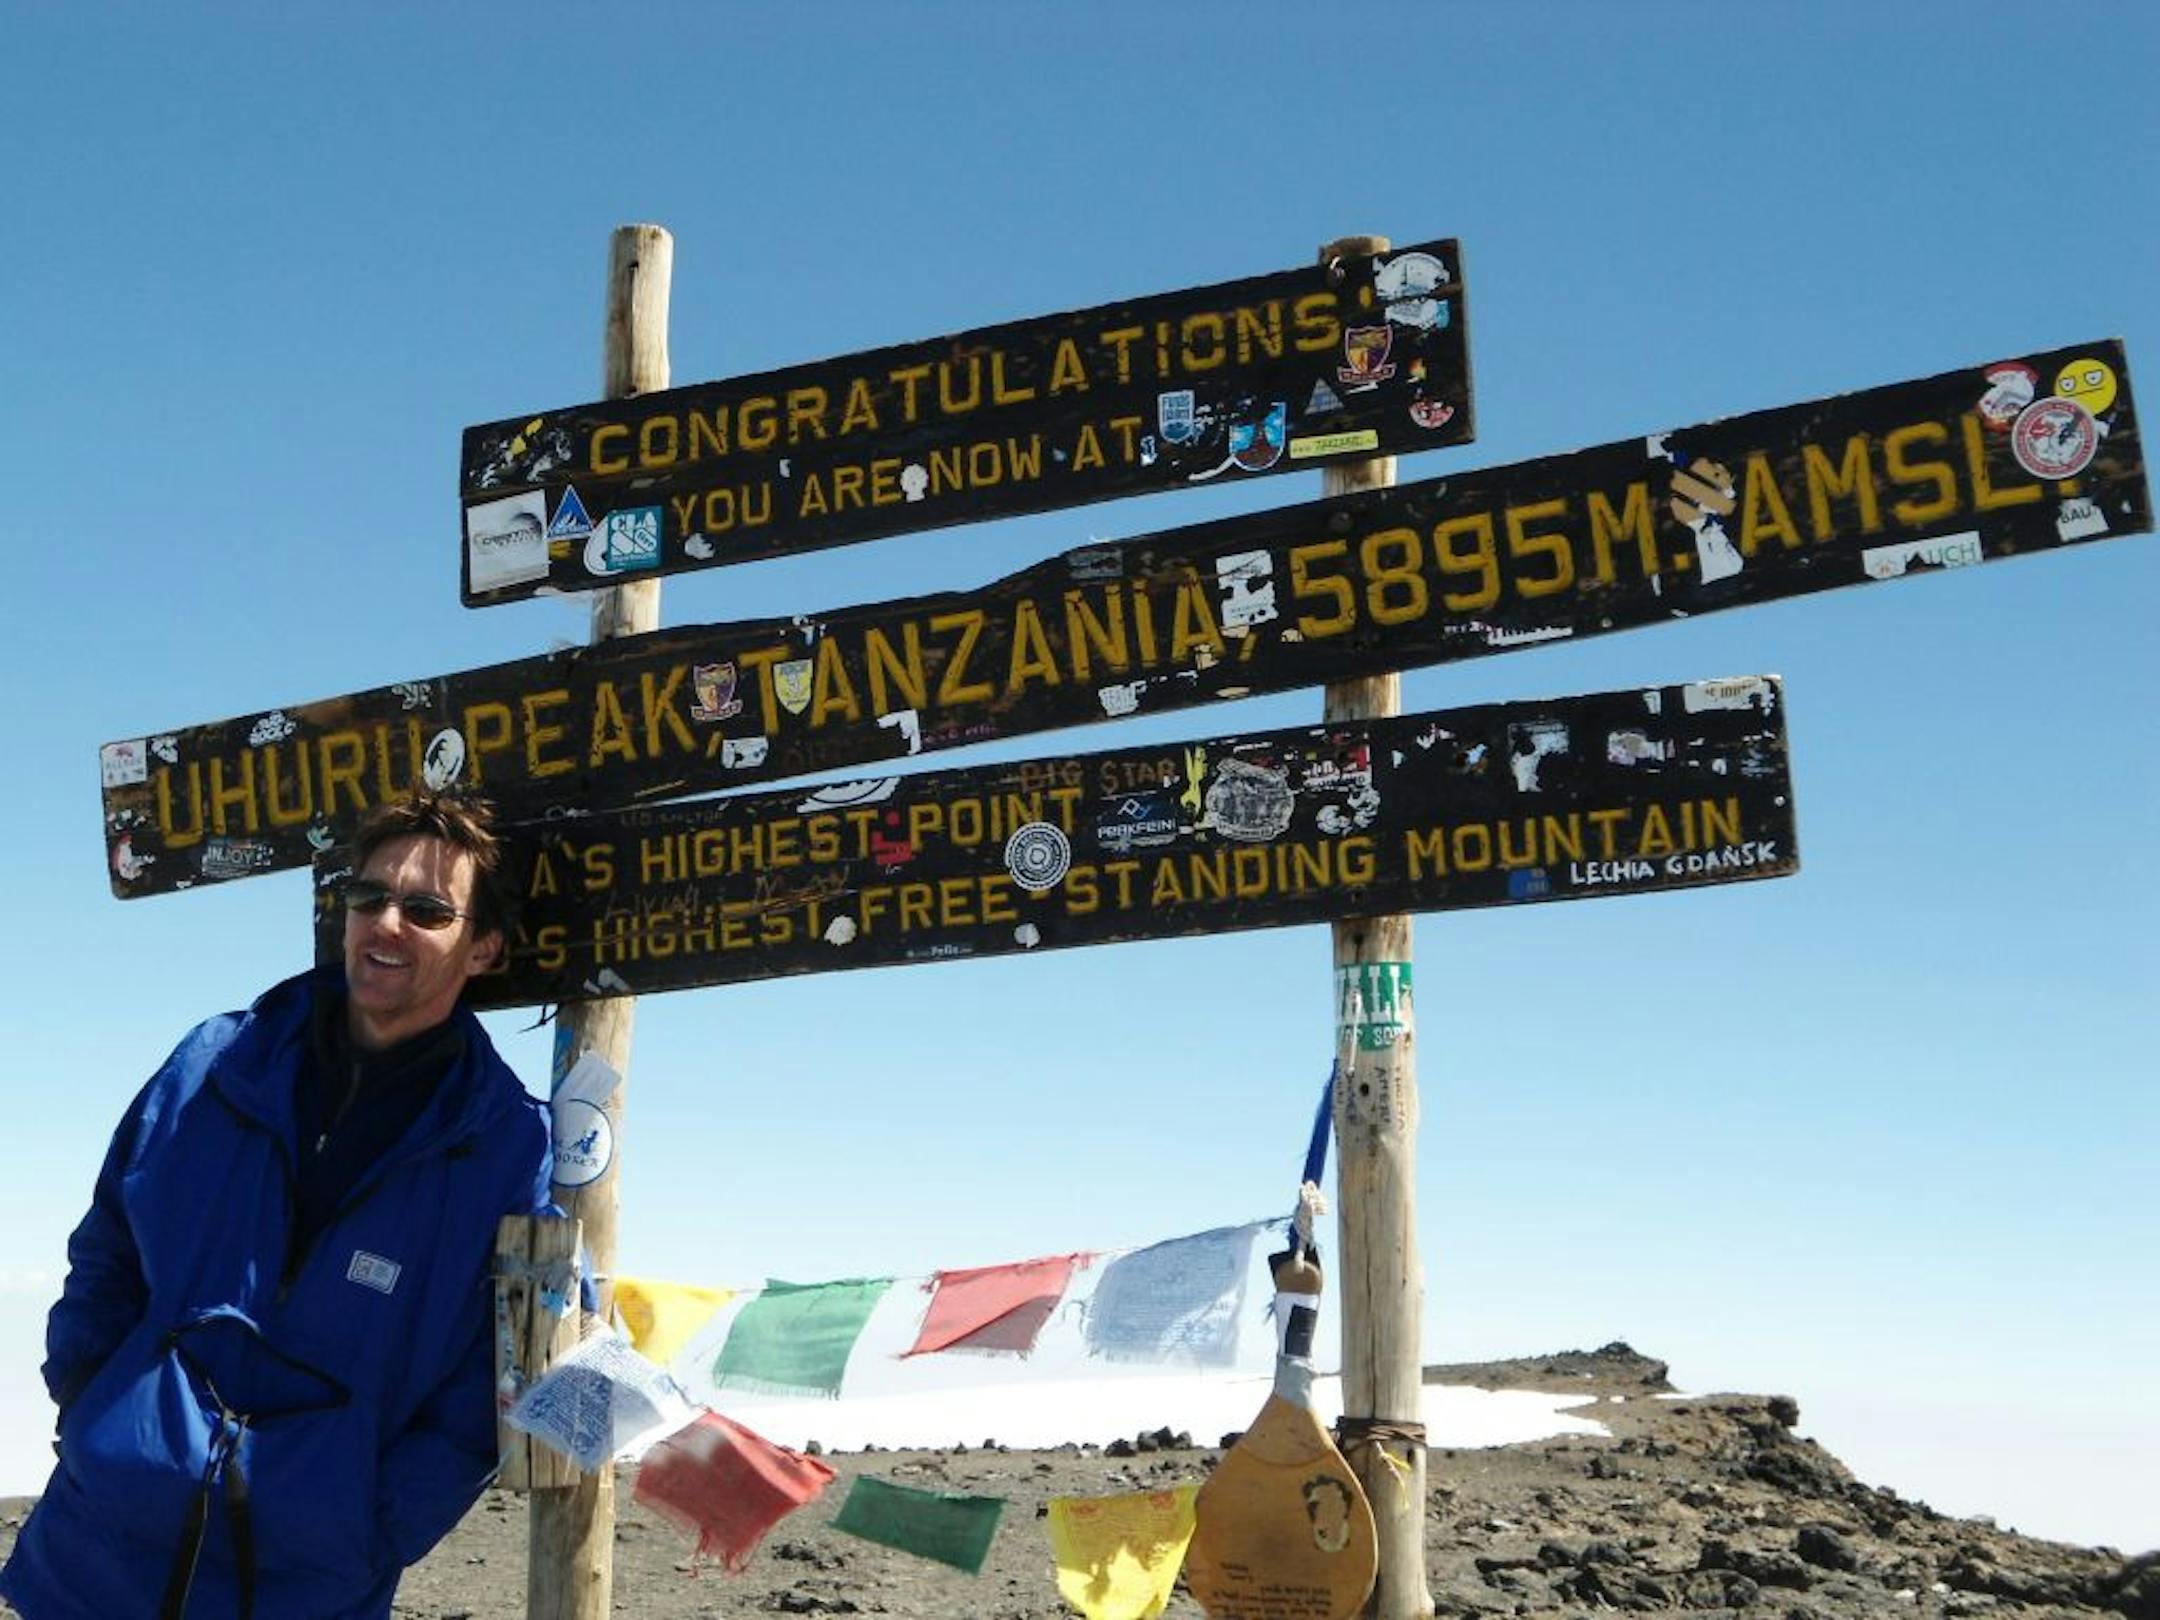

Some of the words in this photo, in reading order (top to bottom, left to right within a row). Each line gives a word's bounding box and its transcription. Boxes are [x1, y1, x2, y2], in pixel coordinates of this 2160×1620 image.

[670, 481, 772, 537] YOU
[799, 457, 903, 518] ARE
[928, 433, 1042, 492] NOW
[1073, 416, 1143, 472] AT
[158, 713, 424, 850] UHURU
[641, 808, 881, 885] HIGHEST
[909, 786, 1084, 852] POINT
[593, 893, 826, 965] HIGHEST
[1408, 797, 1743, 880] MOUNTAIN
[1570, 860, 1656, 886] LECHIA
